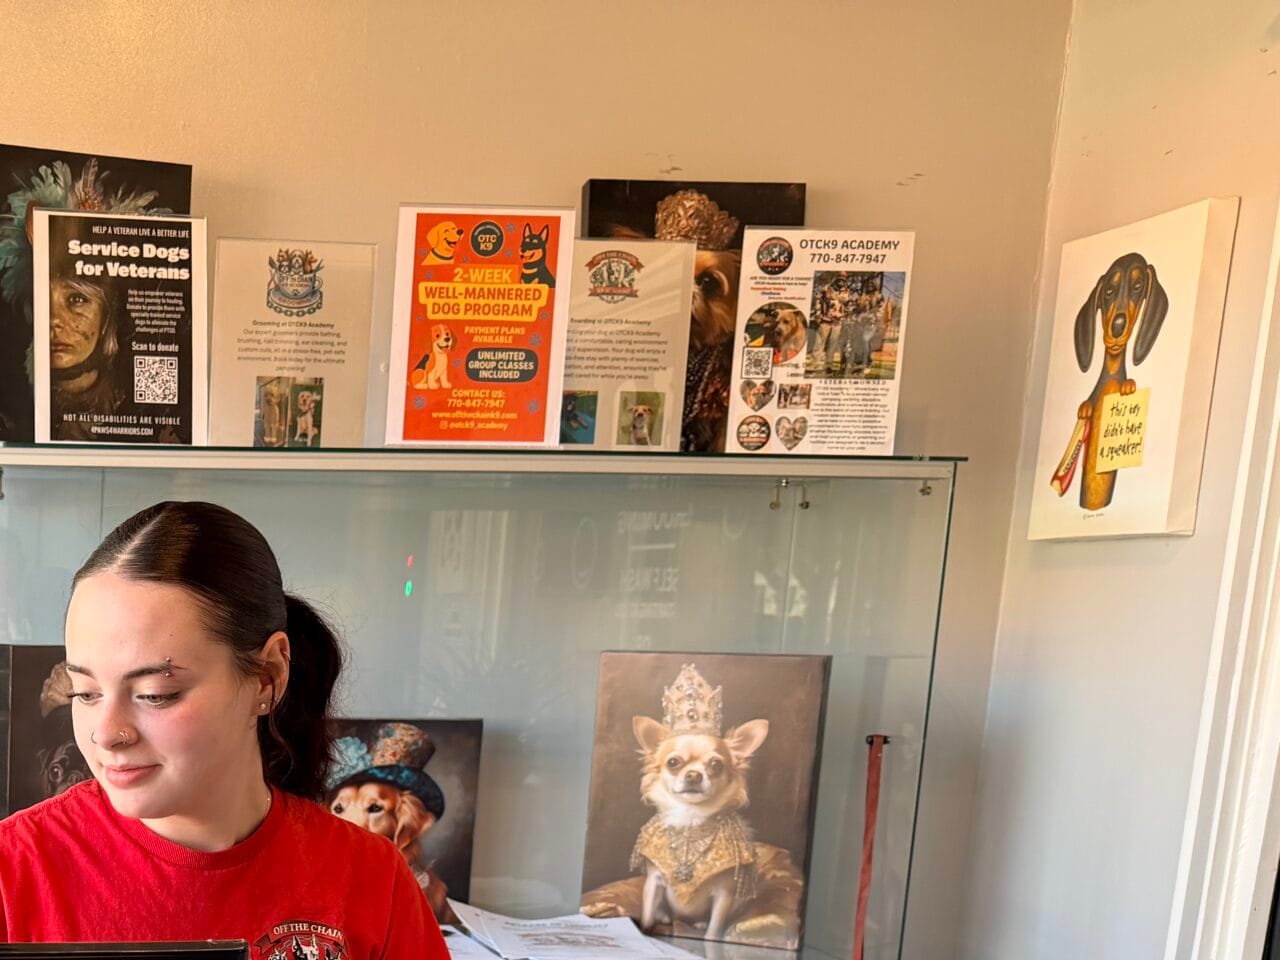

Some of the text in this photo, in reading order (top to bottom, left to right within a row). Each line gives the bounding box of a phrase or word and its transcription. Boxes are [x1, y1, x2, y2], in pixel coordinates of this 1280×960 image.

[92, 226, 106, 234] HELP
[113, 226, 138, 236] VETERAN
[139, 227, 151, 236] LIVE
[157, 229, 177, 238] BETTER
[178, 230, 190, 238] LIFE
[478, 234, 497, 243] OTC
[480, 242, 493, 251] K9
[799, 239, 900, 251] OTCK9 ACADEMY
[68, 239, 190, 263] Service Dogs
[809, 253, 886, 264] 770-847-7947
[75, 260, 190, 280] for Veterans
[453, 267, 512, 283] 2-WEEK
[424, 286, 542, 301] WELL-MANNERED
[431, 302, 533, 317] DOG PROGRAM
[464, 326, 526, 335] PAYMENT PLANS
[472, 335, 513, 344] AVAILABLE
[131, 341, 179, 352] Scan to donate
[477, 351, 525, 360] UNLIMITED
[468, 361, 534, 370] GROUP CLASSES
[479, 370, 520, 379] INCLUDED
[452, 389, 505, 398] CONTACT US:
[447, 399, 505, 408] 770-847-7947
[1110, 401, 1128, 417] this
[63, 414, 181, 426] NOT ALL DISABILITIES ARE VISIBLE
[1104, 419, 1142, 438] didn't have
[273, 923, 344, 940] OFF THE CHAIN
